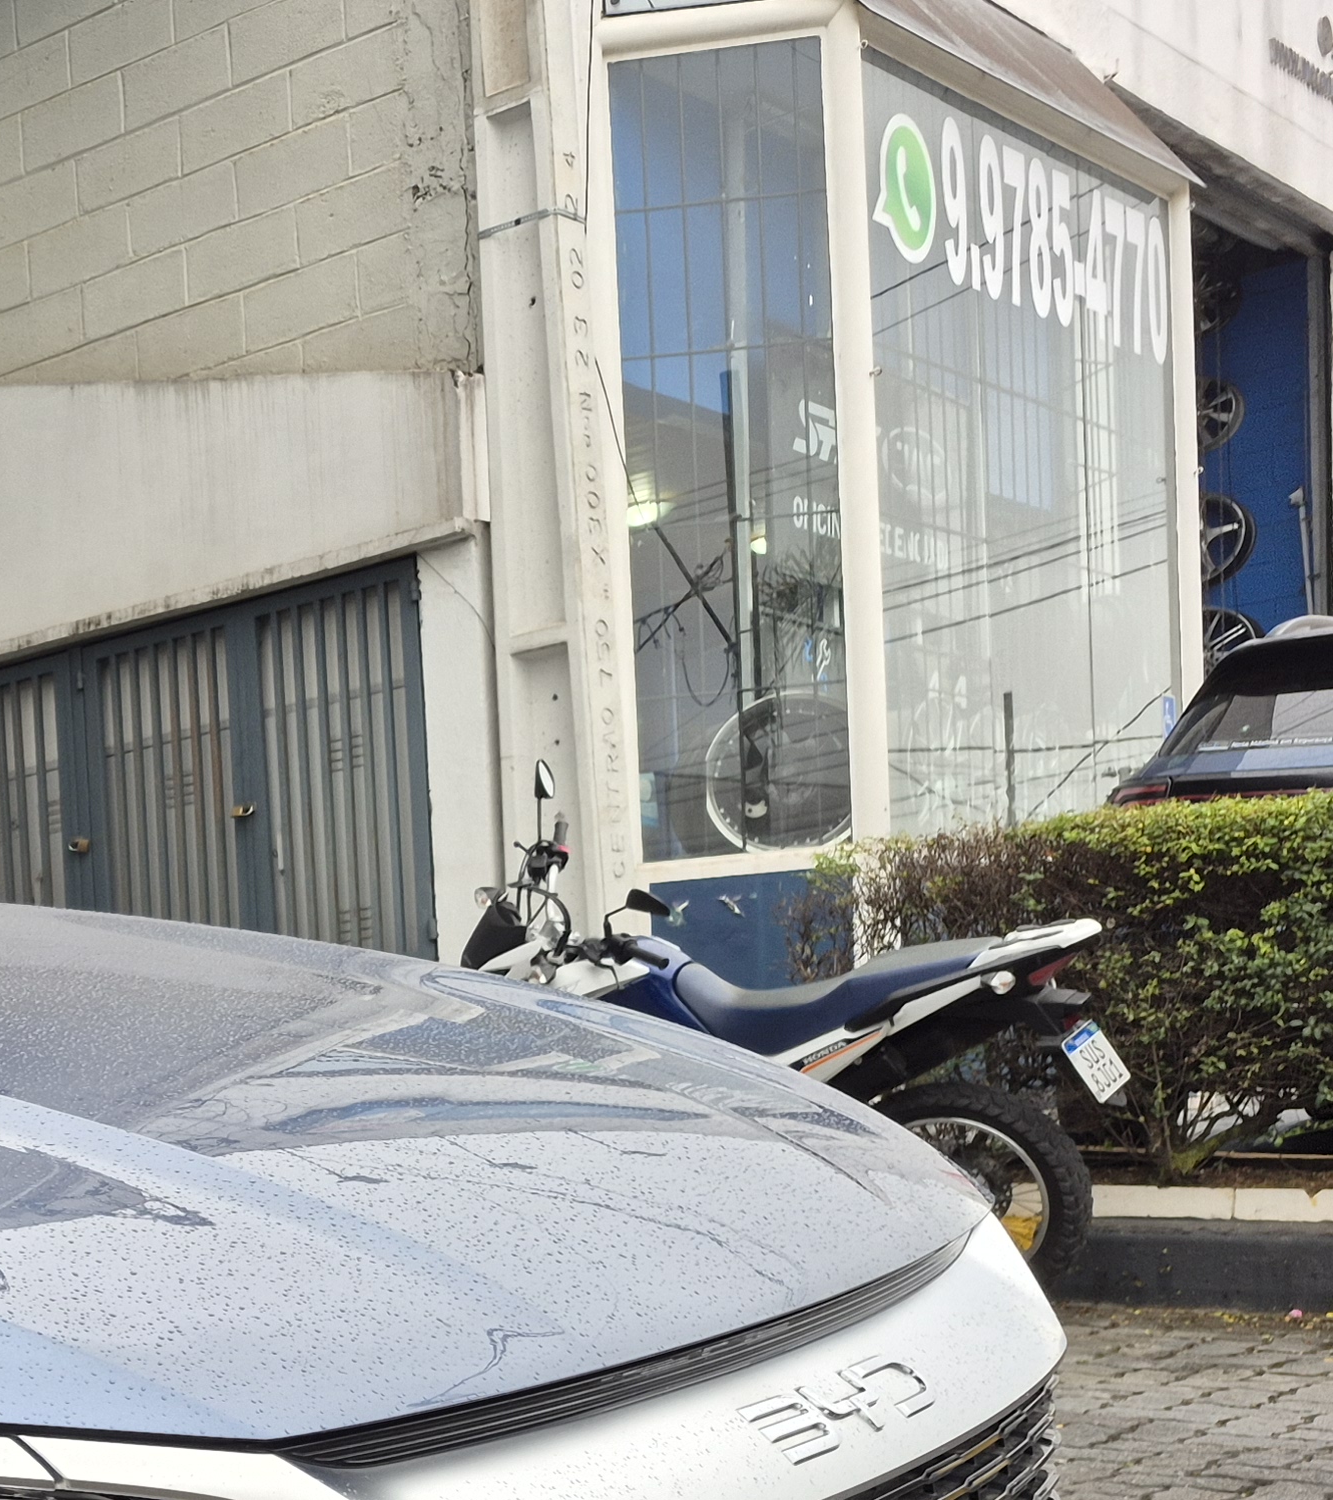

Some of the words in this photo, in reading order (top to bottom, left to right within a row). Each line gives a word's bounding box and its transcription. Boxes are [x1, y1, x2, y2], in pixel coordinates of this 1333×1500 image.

[941, 117, 1167, 366] 9.9785-4770
[802, 1041, 847, 1065] HONDA
[1079, 1039, 1106, 1070] SUS
[736, 1354, 935, 1466] BYD
